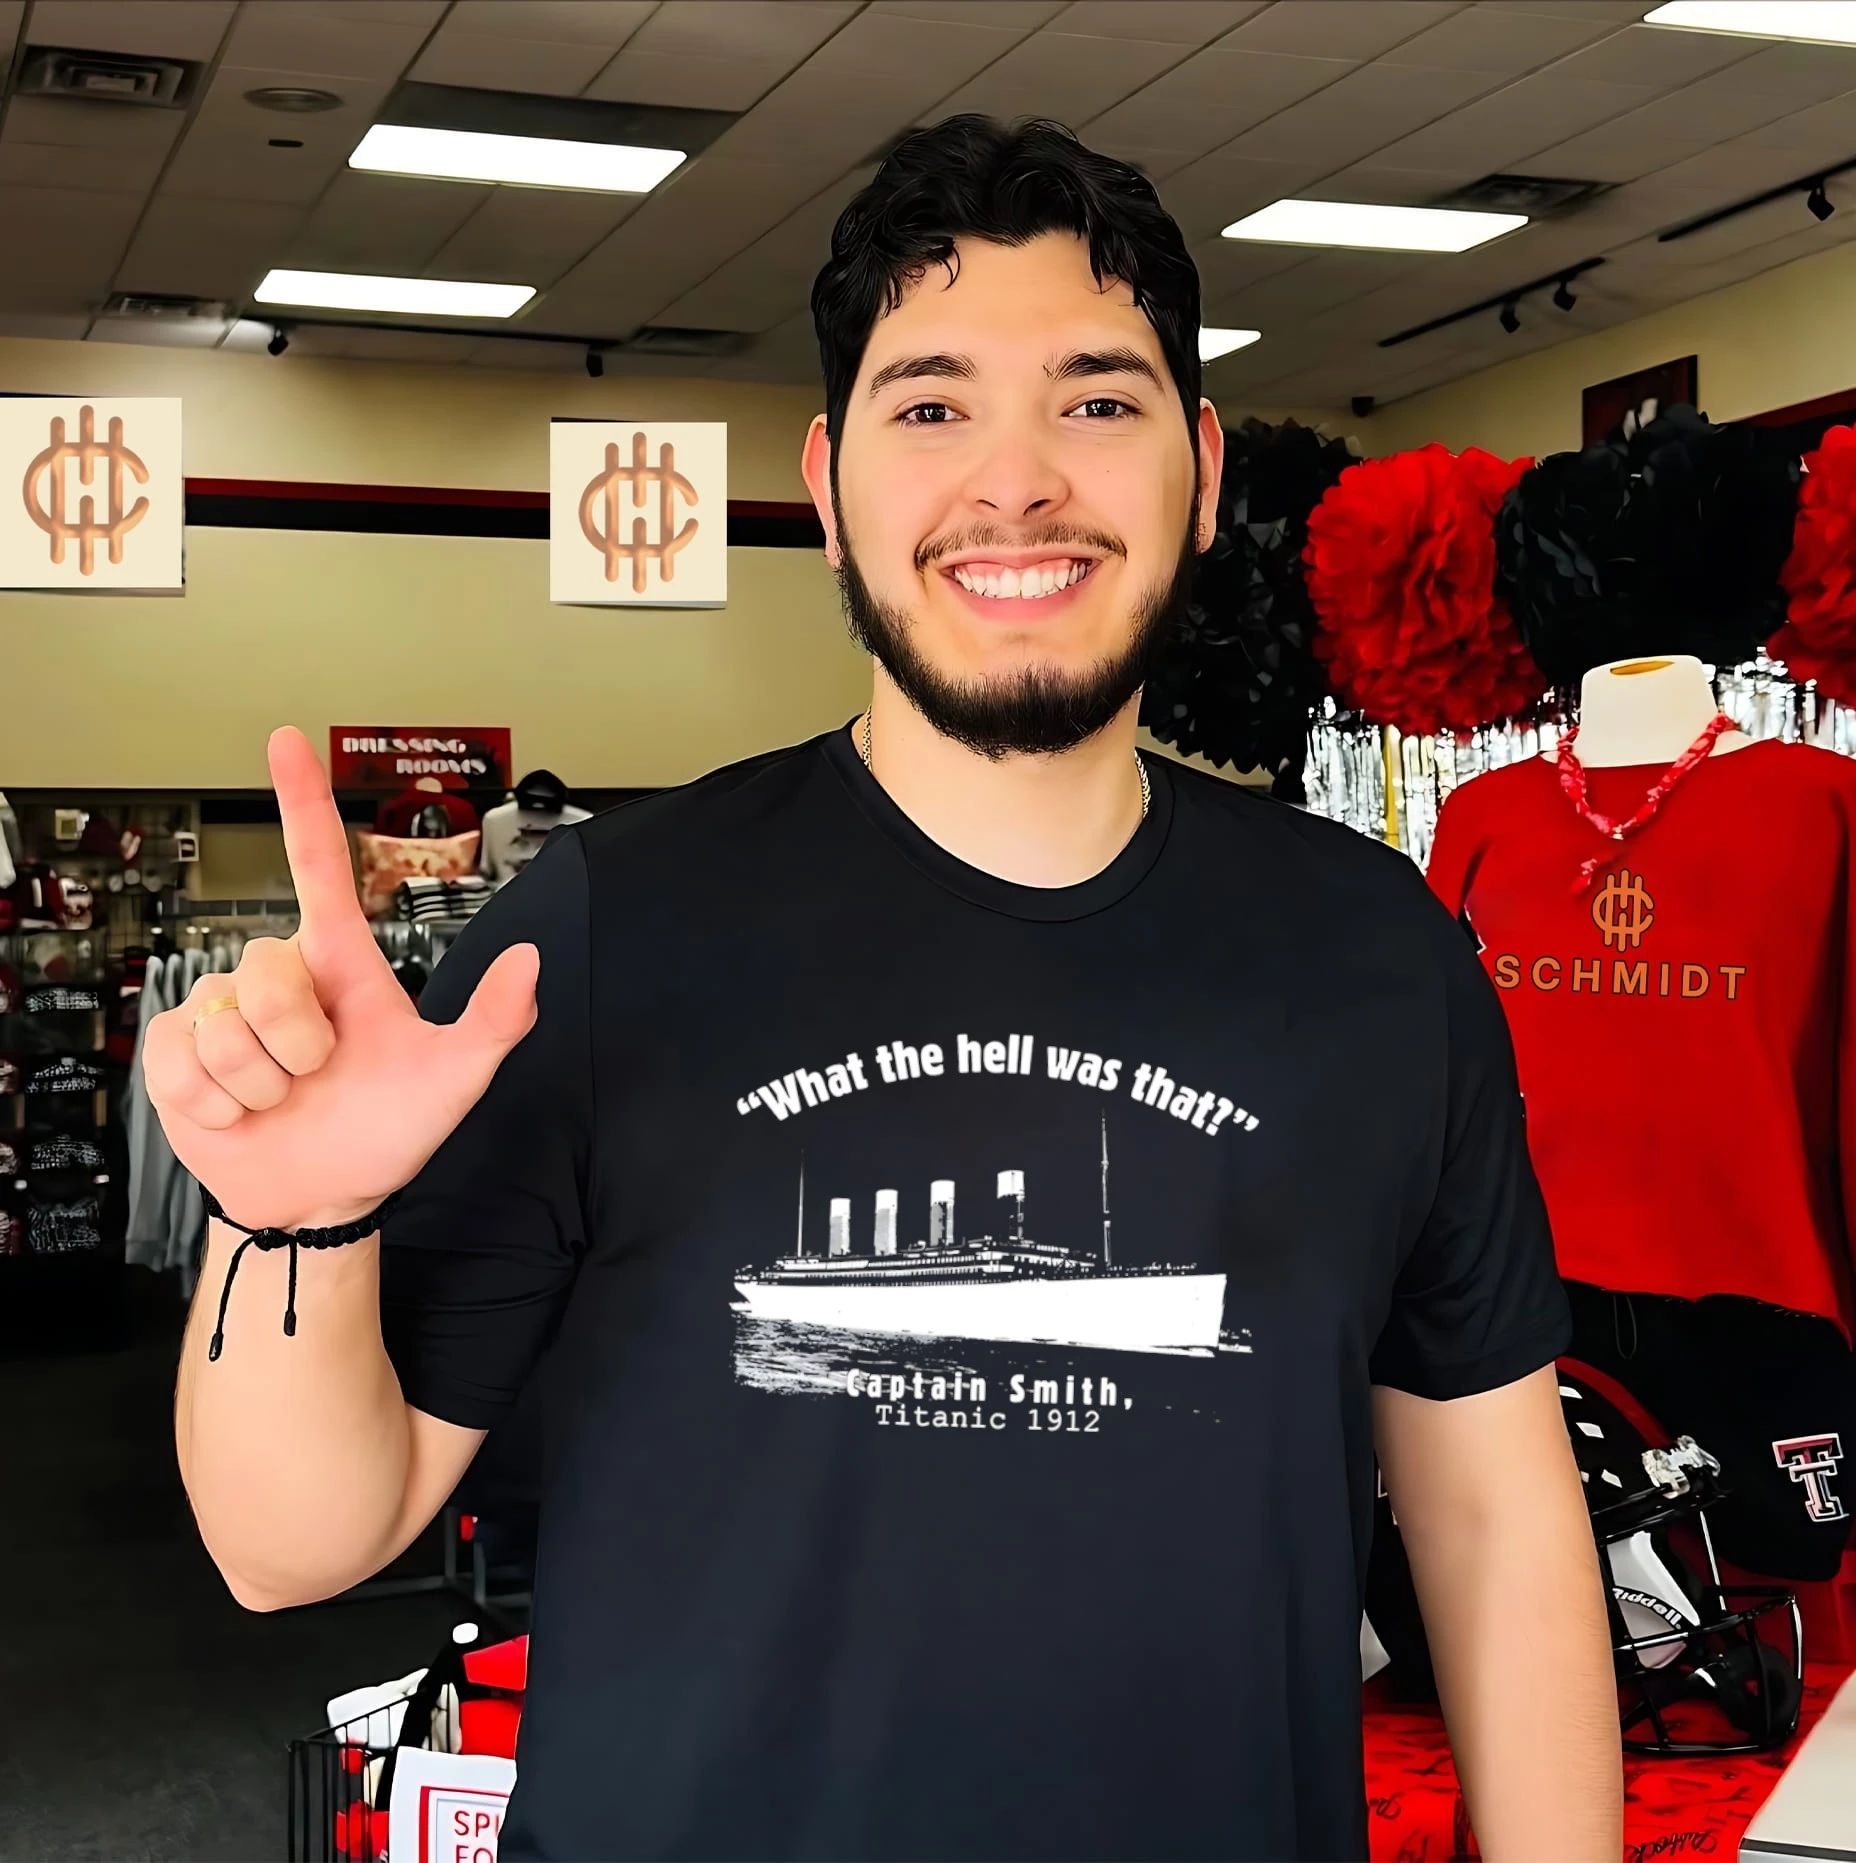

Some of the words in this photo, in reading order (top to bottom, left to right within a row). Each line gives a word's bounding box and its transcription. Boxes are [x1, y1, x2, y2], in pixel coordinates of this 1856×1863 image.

[1494, 954, 1747, 1000] SCHMIDT
[875, 1040, 945, 1084] the
[956, 1033, 1034, 1075] hell
[1046, 1045, 1123, 1091] was
[846, 1368, 987, 1402] Captain
[1009, 1373, 1133, 1411] Smith,
[875, 1403, 1007, 1430] Titanic
[1027, 1408, 1101, 1433] 1912
